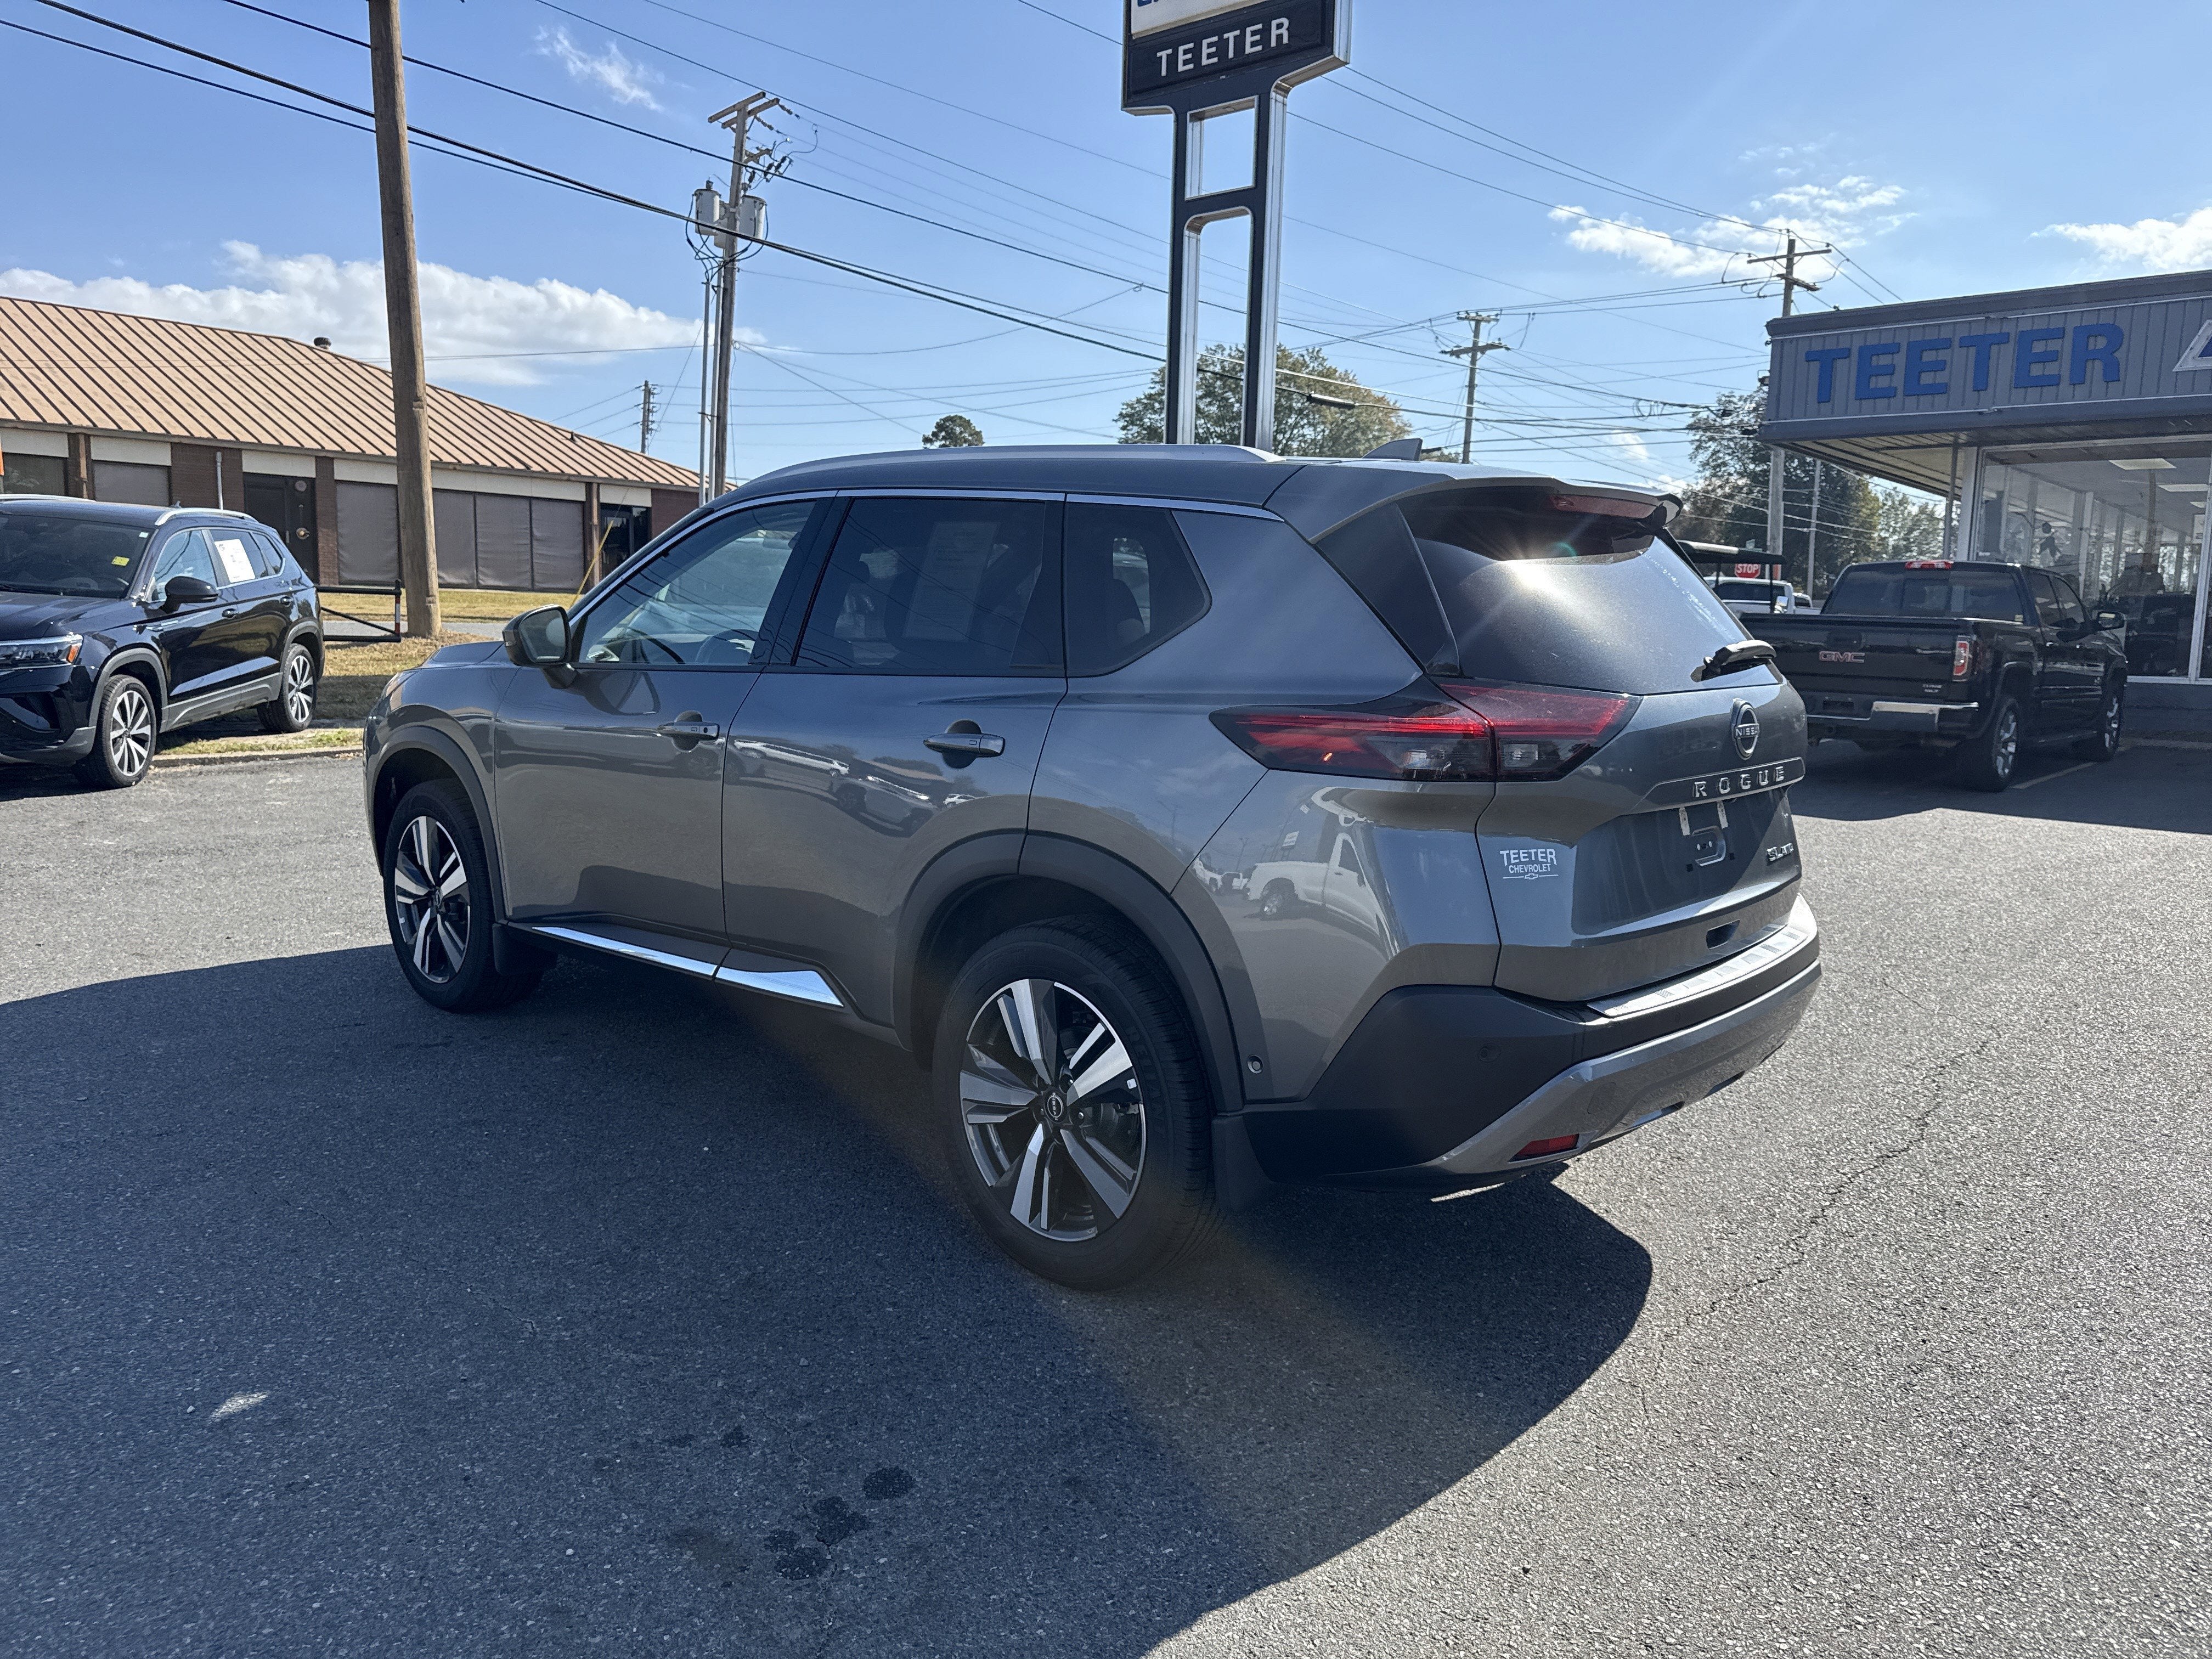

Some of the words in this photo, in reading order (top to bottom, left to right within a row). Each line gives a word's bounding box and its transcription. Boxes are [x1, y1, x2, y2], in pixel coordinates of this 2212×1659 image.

[1156, 17, 1289, 77] TEETER
[1805, 323, 2124, 403] TEETER
[1736, 563, 1759, 574] STOP
[1819, 651, 1865, 663] GMC
[1694, 766, 1785, 798] ROGUE
[1499, 848, 1557, 866] TEETER
[1509, 864, 1551, 873] CHEVROLET
